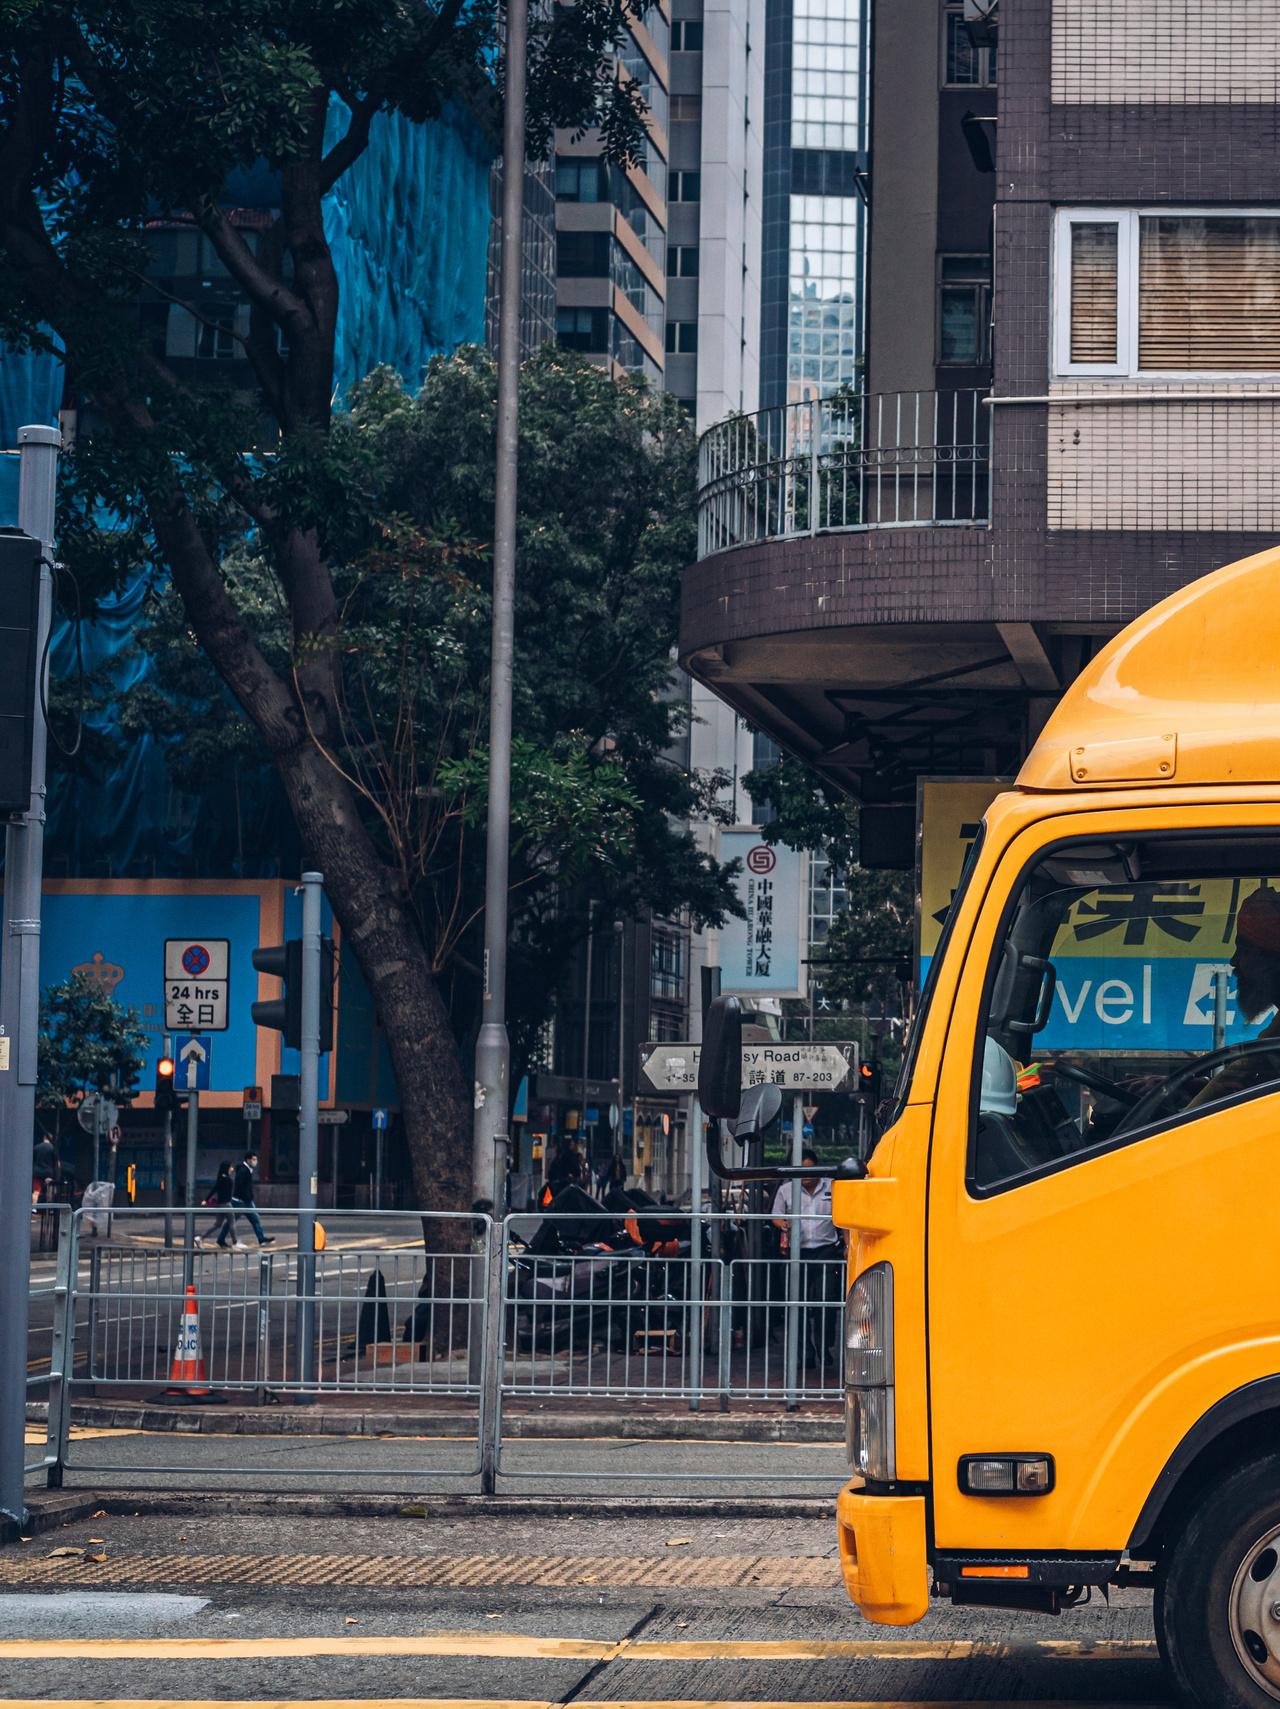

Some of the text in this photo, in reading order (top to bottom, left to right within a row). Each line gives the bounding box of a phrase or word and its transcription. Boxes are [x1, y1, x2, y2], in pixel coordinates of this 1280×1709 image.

[745, 948, 753, 977] TOWER
[171, 986, 219, 1000] 24 hrs
[1048, 965, 1151, 1025] vel
[176, 1003, 214, 1025] 全日
[764, 1050, 800, 1062] Road
[741, 1069, 786, 1086] 詩道
[793, 1073, 833, 1082] 87-203
